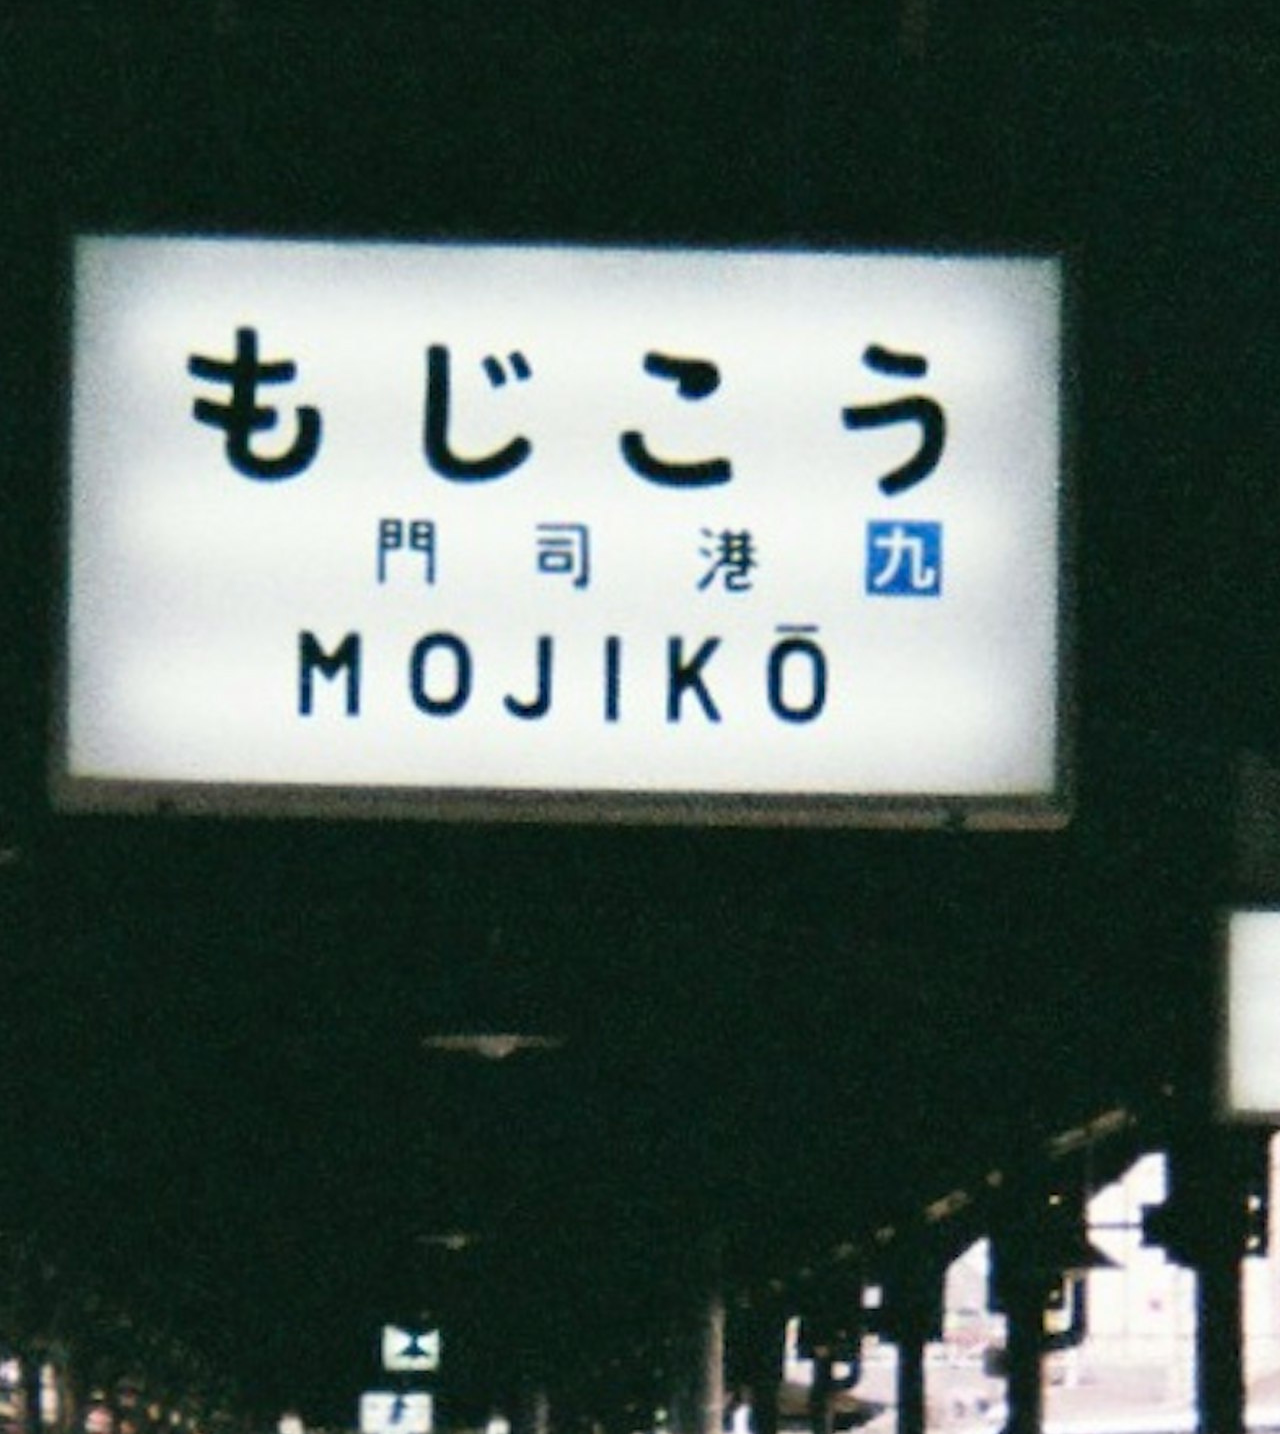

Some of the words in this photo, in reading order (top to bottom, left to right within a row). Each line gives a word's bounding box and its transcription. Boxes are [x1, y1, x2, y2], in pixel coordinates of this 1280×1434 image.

[186, 326, 948, 497] もじこう
[376, 517, 758, 593] 門司港
[874, 526, 936, 589] 九
[296, 624, 829, 725] MOJIKŌ
